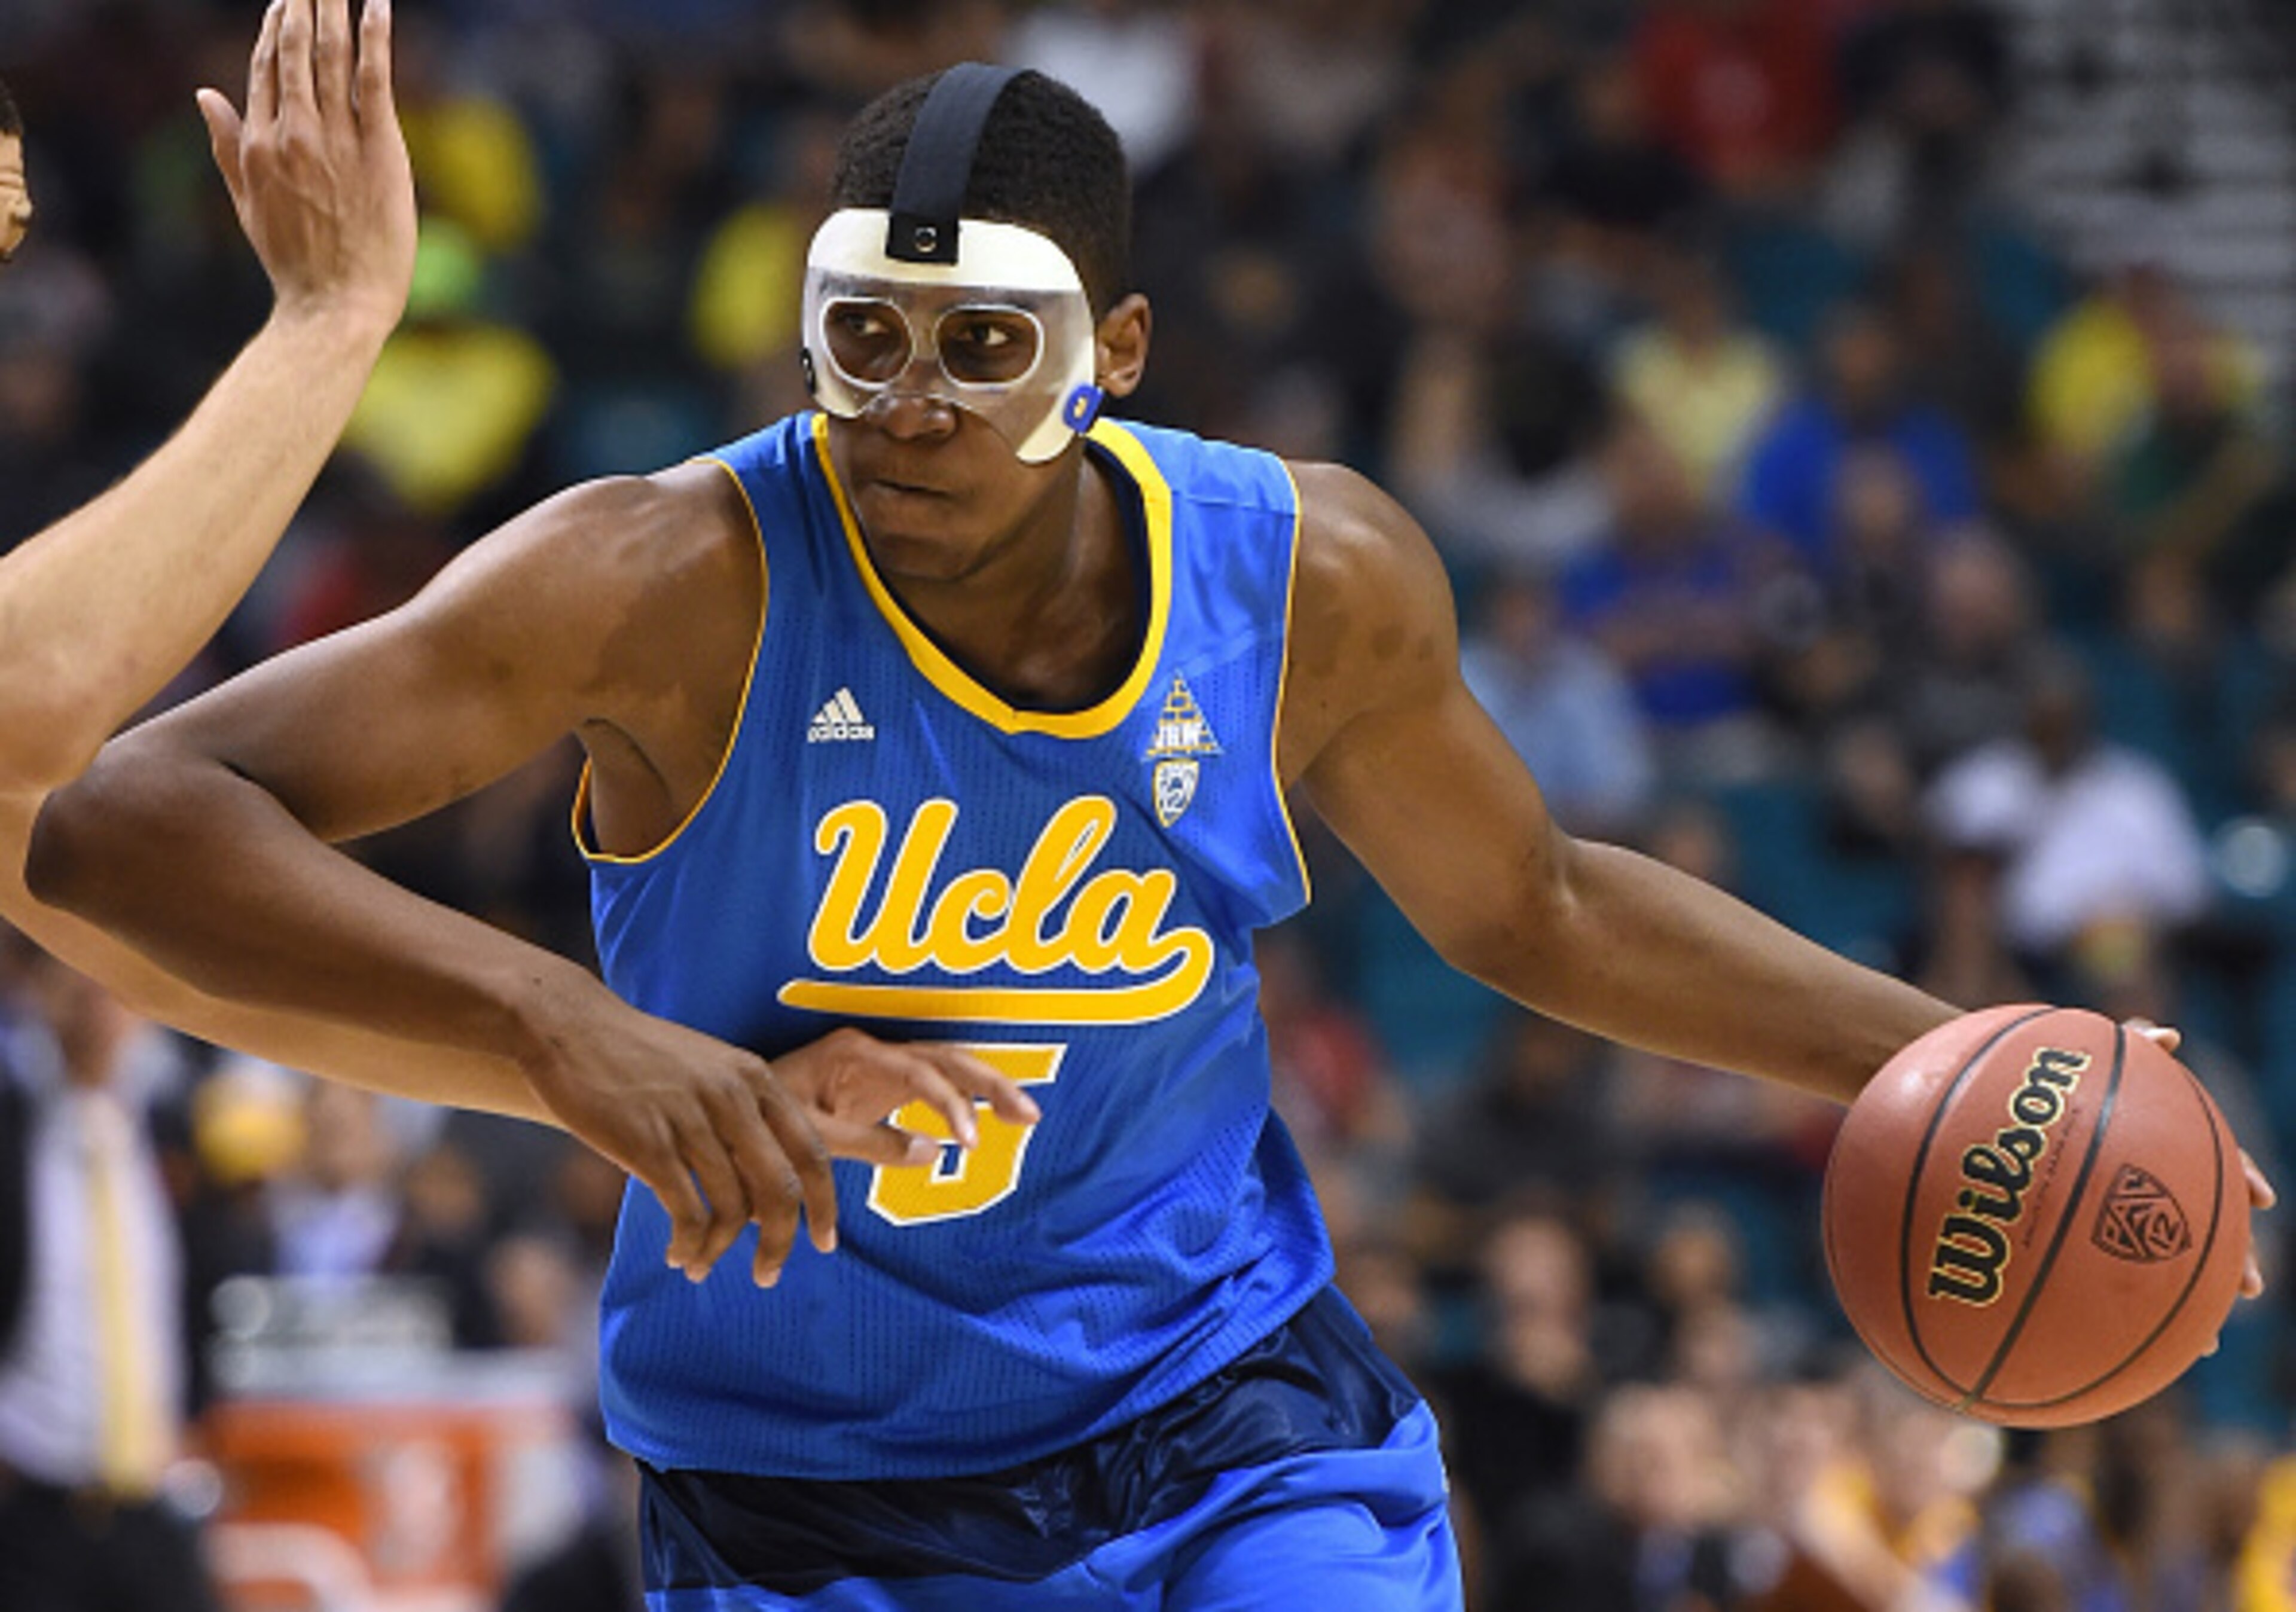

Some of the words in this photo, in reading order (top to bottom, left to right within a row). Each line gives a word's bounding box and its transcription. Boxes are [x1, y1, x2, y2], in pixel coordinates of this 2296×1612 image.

[808, 725, 875, 743] adidas
[807, 795, 1214, 976] Ucla
[1927, 1047, 2091, 1307] Wilson
